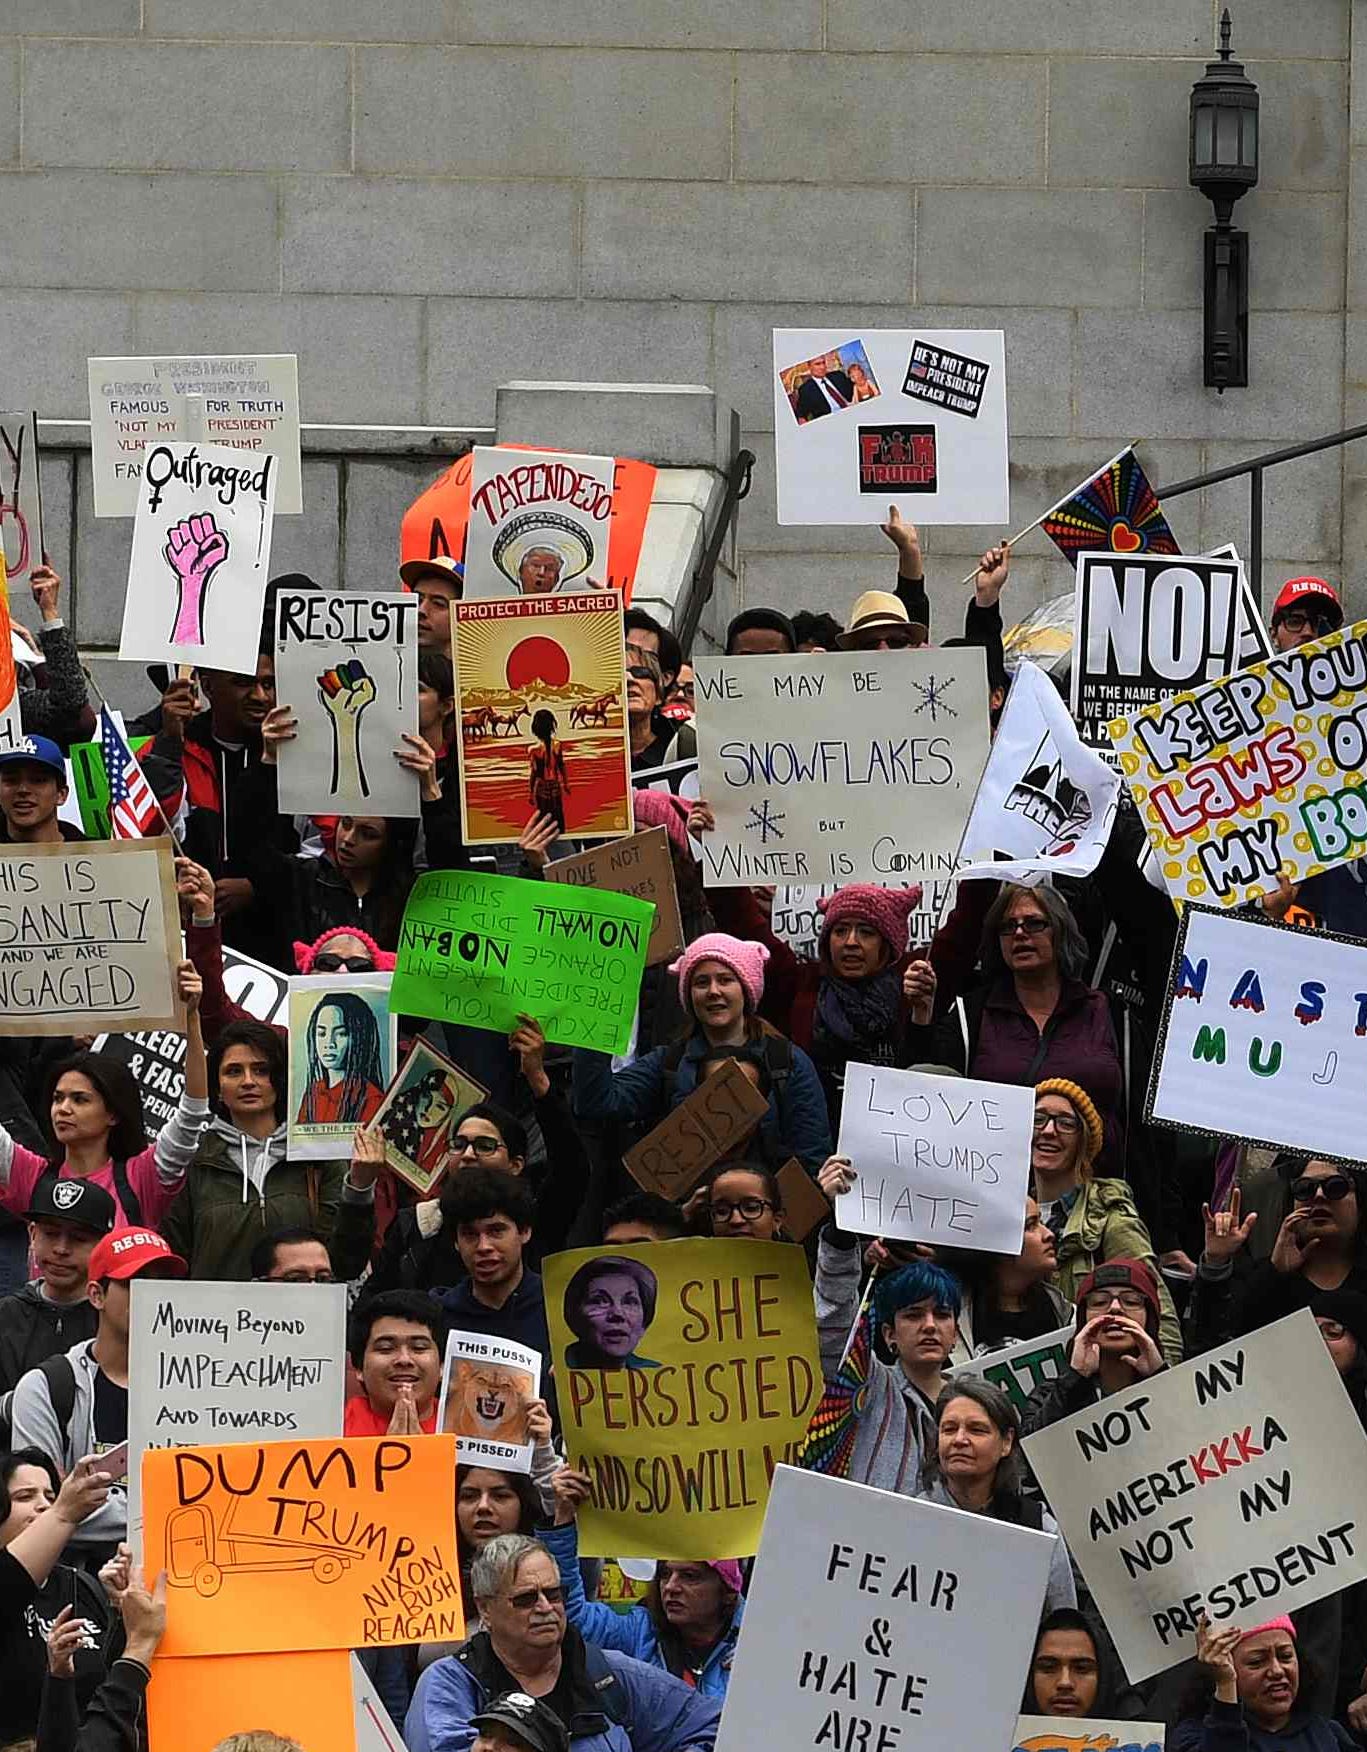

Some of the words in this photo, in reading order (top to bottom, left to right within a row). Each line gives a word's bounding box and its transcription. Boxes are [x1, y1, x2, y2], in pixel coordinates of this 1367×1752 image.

[111, 401, 169, 413] FAMOUS
[207, 401, 230, 412] FOR
[237, 401, 283, 412] TRUTH
[158, 420, 176, 431] MY
[147, 446, 272, 513] Outraged
[472, 463, 612, 525] TAPENDEJO
[860, 463, 936, 484] TRUMP
[279, 597, 418, 644] RESIST
[459, 602, 523, 618] PROTECT
[525, 600, 553, 615] THE
[557, 596, 616, 612] SACRED
[1085, 565, 1235, 681] NO!
[697, 671, 744, 701] WE
[774, 674, 826, 697] MAY
[853, 671, 882, 692] BE
[1084, 685, 1097, 700] IN
[1100, 686, 1125, 700] THE
[1129, 686, 1155, 700] NAME
[1134, 675, 1265, 774] KEEP
[65, 860, 96, 893] IS
[706, 843, 809, 879] WINTER
[832, 853, 854, 874] IS
[1199, 818, 1279, 897] MY
[867, 1078, 1003, 1131] LOVE
[881, 1130, 1002, 1185] TRUMPS
[859, 1176, 979, 1233] HATE
[111, 1234, 167, 1255] RESIST
[683, 1274, 782, 1343] SHE
[457, 1341, 488, 1355] THIS
[493, 1347, 532, 1365] PUSSY
[156, 1406, 199, 1428] AND
[205, 1406, 298, 1430] TOWARDS
[569, 1356, 814, 1430] PERSISTED
[1075, 1397, 1151, 1462] NOT
[1194, 1351, 1246, 1405] MY
[175, 1441, 412, 1506] DUMP
[468, 1441, 517, 1459] PISSED!
[1088, 1416, 1289, 1541] AMERIKKKA
[266, 1497, 415, 1564] TRUMP
[1120, 1516, 1194, 1580] NOT
[1239, 1470, 1292, 1522] MY
[364, 1545, 445, 1616] NIXON
[826, 1544, 959, 1612] FEAR
[1153, 1523, 1356, 1645] PRESIDENT
[362, 1611, 455, 1643] REAGAN
[800, 1651, 928, 1716] HATE
